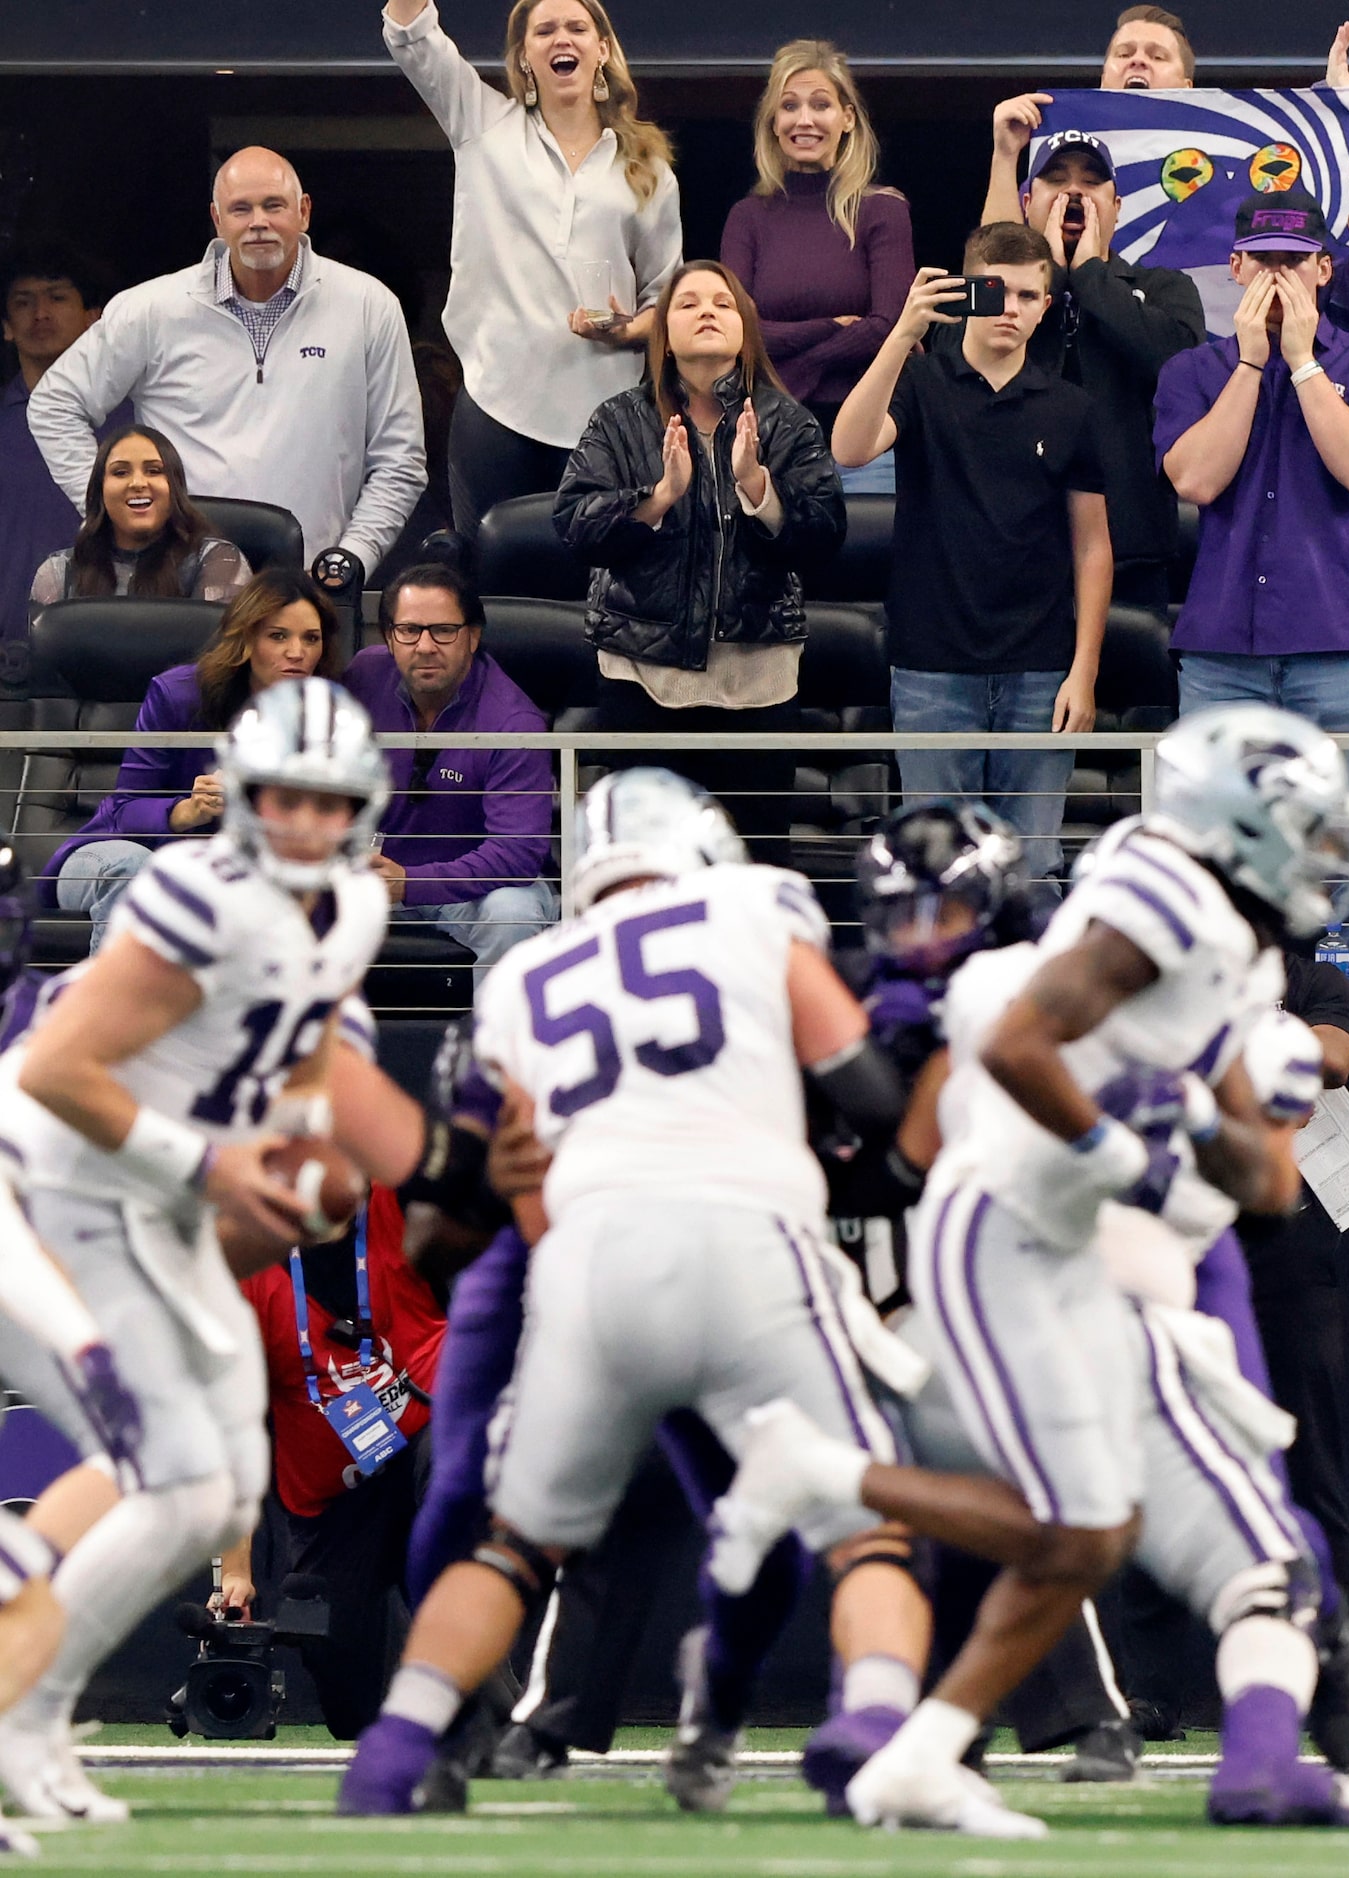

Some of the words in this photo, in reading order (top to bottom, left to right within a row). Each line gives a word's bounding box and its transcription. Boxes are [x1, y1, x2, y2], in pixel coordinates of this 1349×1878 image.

[1251, 209, 1309, 231] Frogs
[299, 346, 326, 359] TCU
[440, 768, 464, 783] TCU
[523, 900, 726, 1118] 55
[374, 1446, 394, 1463] ABC
